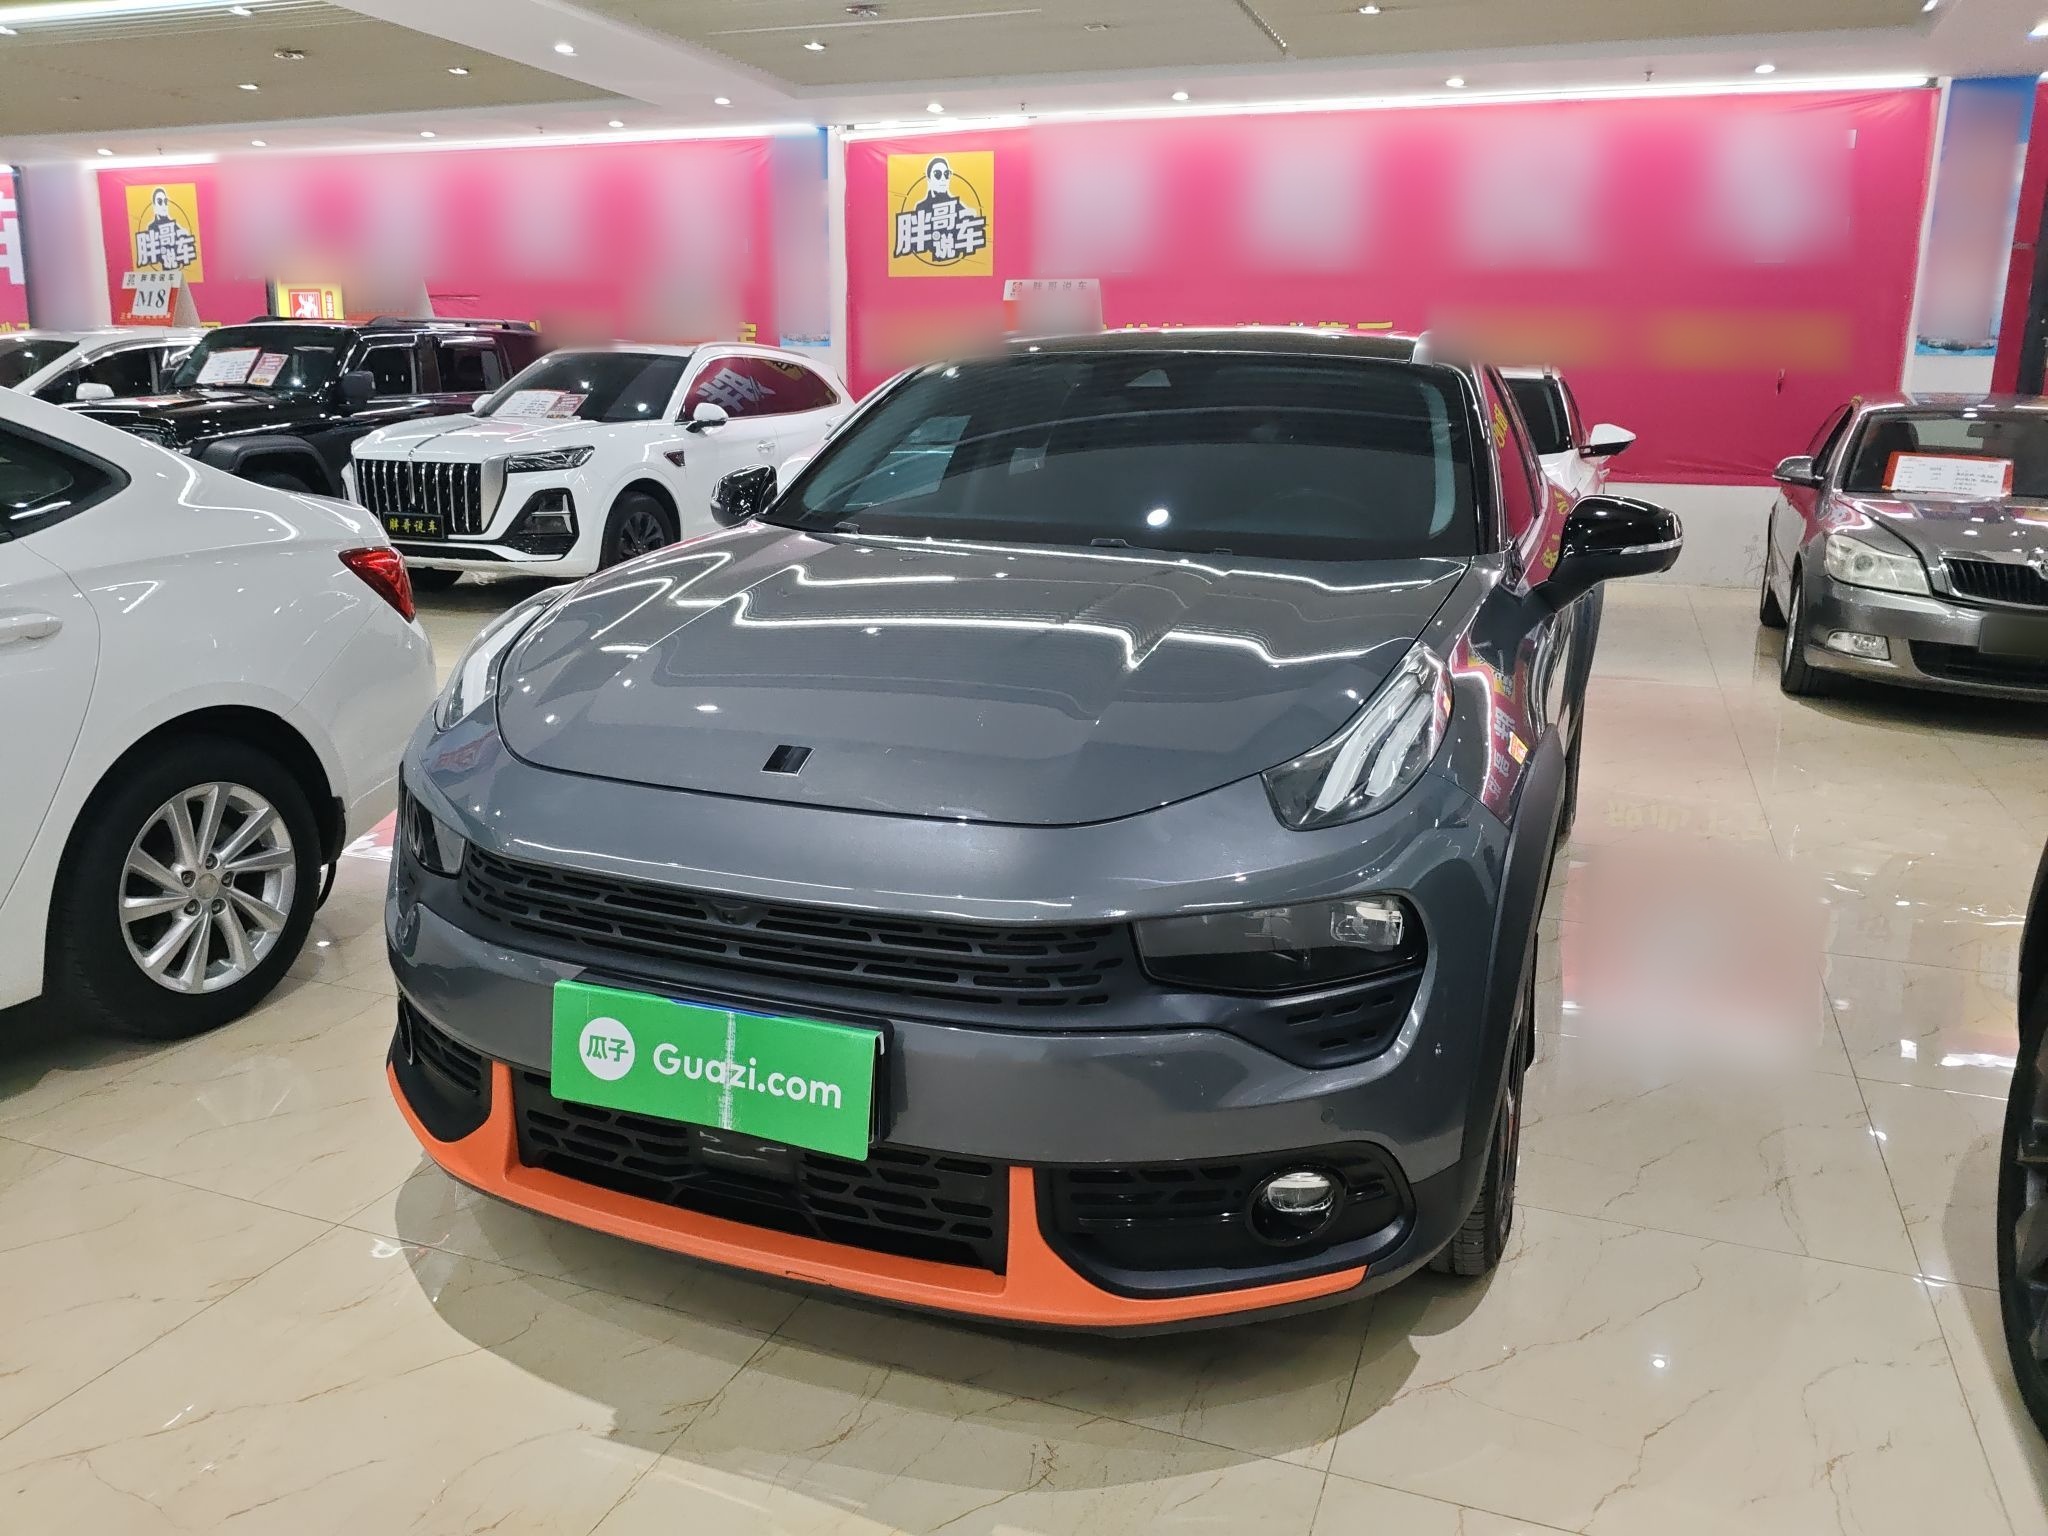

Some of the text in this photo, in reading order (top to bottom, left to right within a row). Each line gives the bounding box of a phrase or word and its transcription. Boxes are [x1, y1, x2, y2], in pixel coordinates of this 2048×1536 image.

[136, 221, 196, 270] 胖哥说车
[895, 199, 985, 259] 胖哥说车
[389, 518, 437, 534] 胖哥说车
[586, 1034, 842, 1109] 瓜子 Guazi.com
